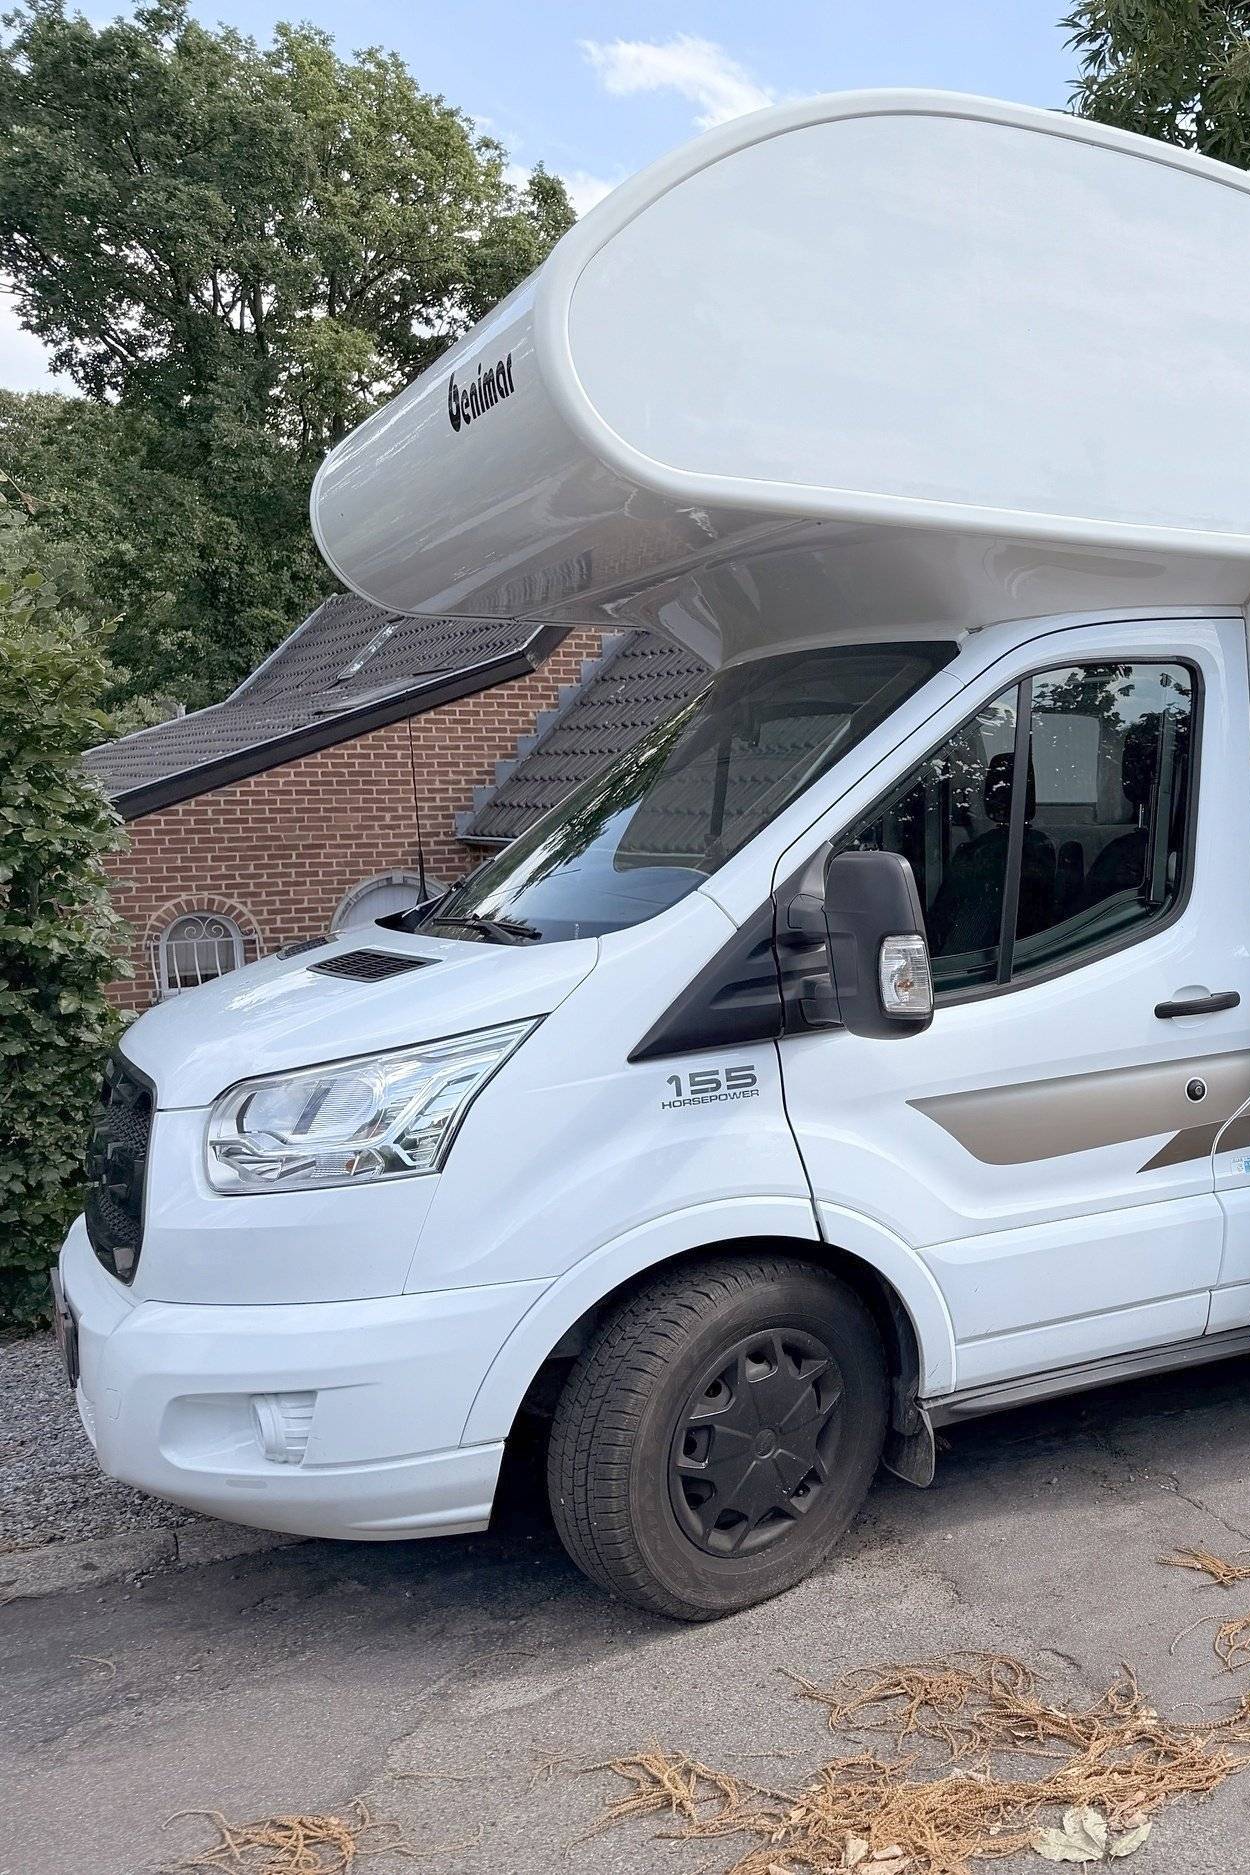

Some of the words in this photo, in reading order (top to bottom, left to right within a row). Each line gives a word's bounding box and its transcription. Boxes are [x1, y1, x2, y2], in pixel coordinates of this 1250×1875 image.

[448, 352, 514, 432] benimar
[667, 1065, 757, 1097] 155
[661, 1089, 759, 1110] HORSEPOWER
